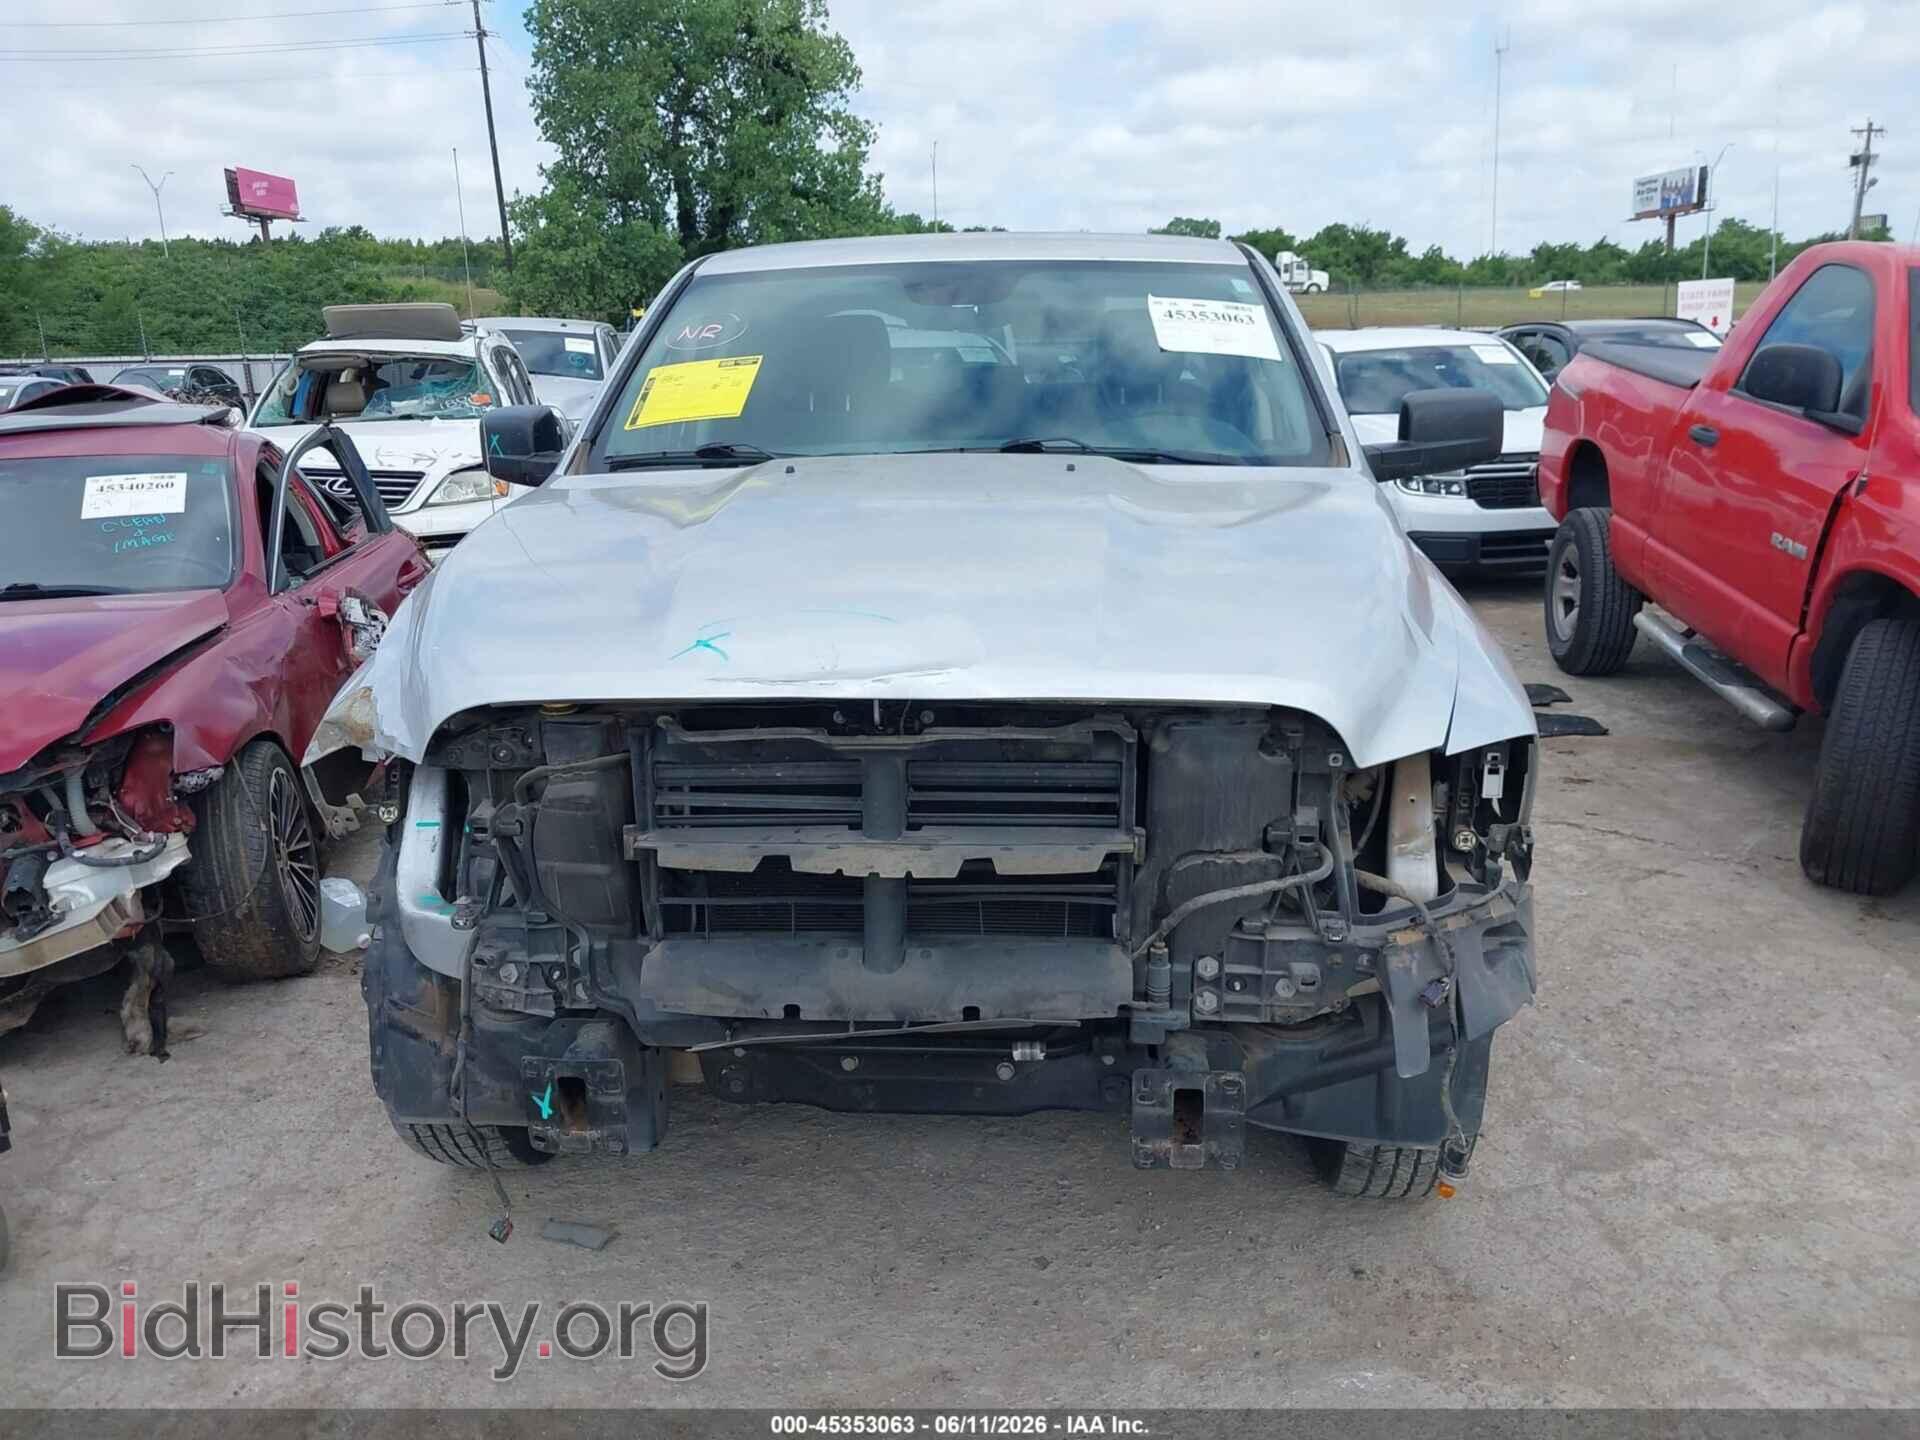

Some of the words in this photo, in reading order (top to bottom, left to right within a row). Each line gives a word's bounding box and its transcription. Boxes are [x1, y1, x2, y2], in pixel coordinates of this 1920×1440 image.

[1163, 309, 1255, 326] 45353063
[677, 323, 723, 341] NR
[96, 481, 175, 493] 45340260
[1771, 532, 1808, 560] RAM
